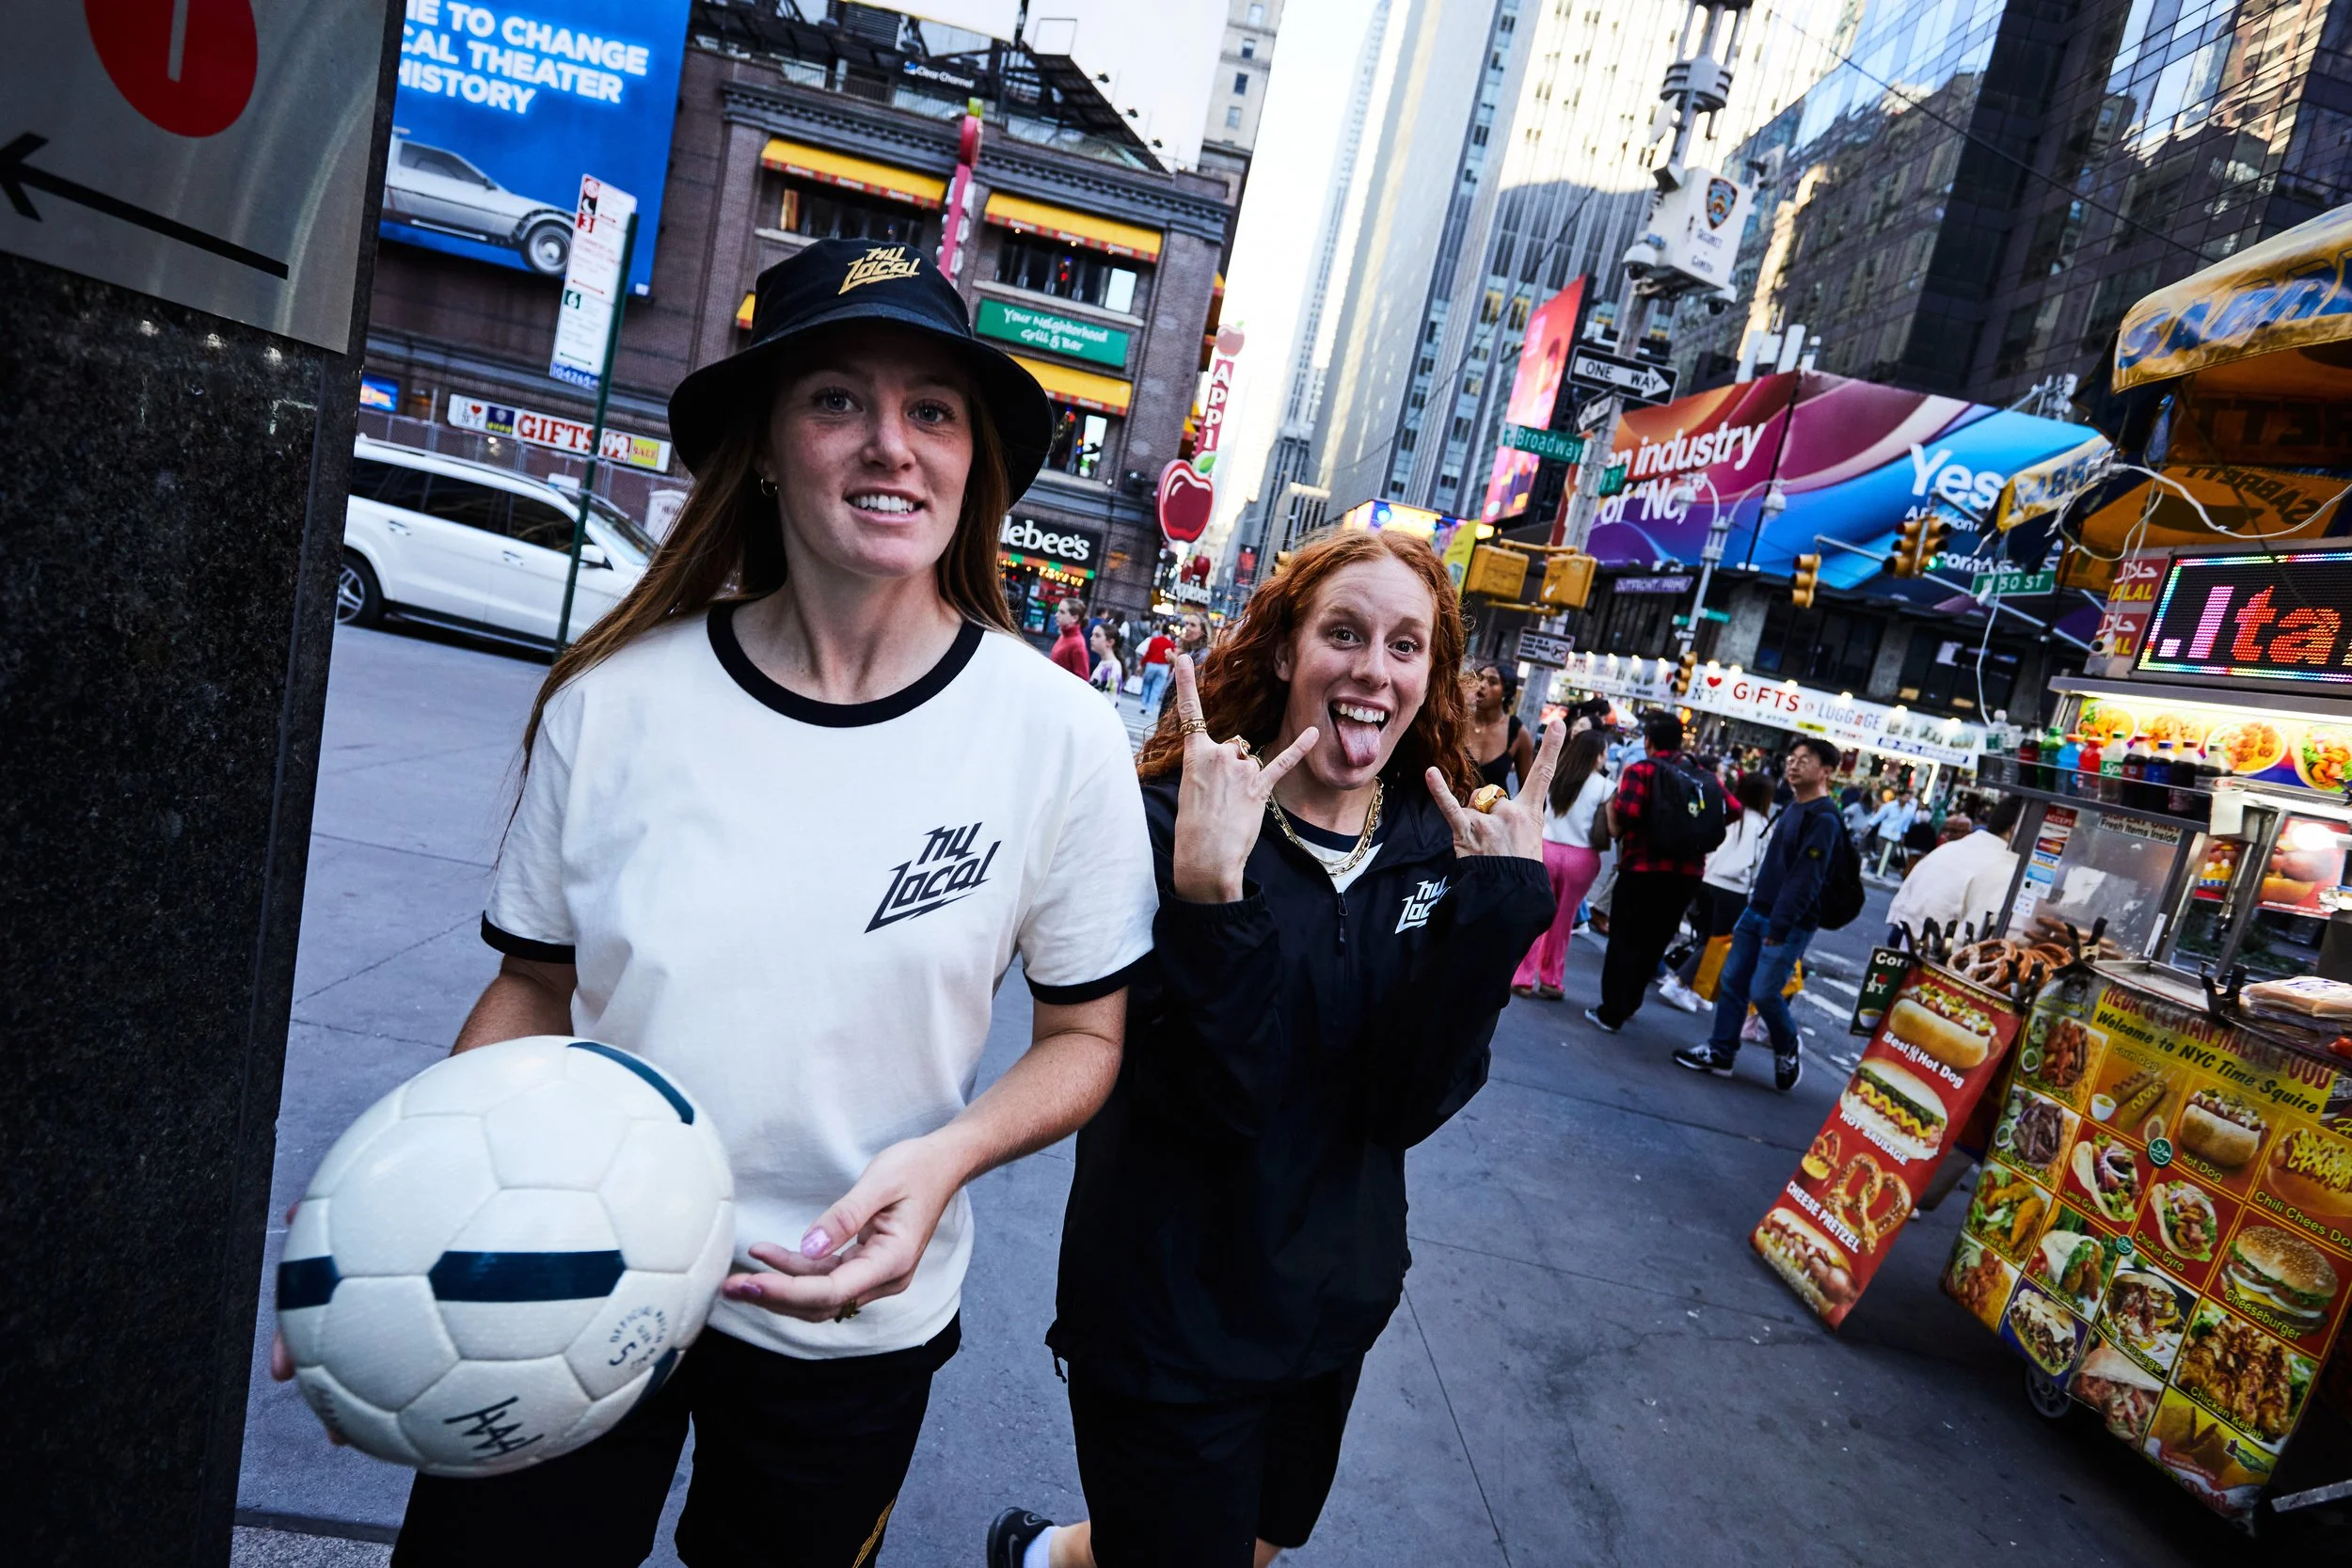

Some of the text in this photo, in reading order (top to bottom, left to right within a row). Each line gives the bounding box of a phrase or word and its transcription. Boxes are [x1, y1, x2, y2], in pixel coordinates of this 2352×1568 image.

[447, 2, 496, 38] TO
[501, 16, 650, 76] CHANGE
[468, 40, 624, 103] THEATER
[916, 65, 976, 89] Clear Channel
[580, 216, 592, 230] 3
[567, 293, 579, 308] 6
[1004, 308, 1108, 342] Your Neighborhood
[1021, 329, 1049, 343] Grill
[1062, 338, 1084, 351] Bar
[1585, 361, 1661, 391] ONE WAY
[518, 412, 594, 453] GIFTS
[1516, 428, 1582, 464] Broadway
[1633, 420, 1767, 477] industry
[1910, 443, 2004, 510] Yes
[1600, 483, 1632, 525] of
[1905, 505, 1918, 519] A
[1001, 515, 1090, 562] lebee's
[1661, 578, 1688, 593] PRIME
[1999, 576, 2020, 592] 50
[2025, 575, 2044, 590] ST
[1692, 687, 1719, 703] NY
[1733, 682, 1800, 712] GIFTS
[2045, 814, 2074, 828] ACCEPT
[2100, 818, 2178, 845] Fresh Items Inside
[1883, 1031, 1910, 1055] Best
[1916, 1051, 1941, 1073] Hot
[1939, 1065, 1965, 1090] Dog
[2096, 1010, 2320, 1114] Welcome to NYC Time Squire
[2113, 1044, 2158, 1073] Corn Dog
[1839, 1110, 1909, 1166] HOT SAUSAGE
[1993, 1146, 2055, 1188] Lamb Over Rice
[2182, 1152, 2223, 1183] Hot Dog
[1787, 1180, 1862, 1254] CHEESE PRETZEL
[2061, 1186, 2102, 1215] Lamb Gyro
[2254, 1191, 2352, 1253] Chili Chees Do
[2135, 1230, 2185, 1273] Chicken Gyro
[2224, 1289, 2301, 1341] Cheeseburger
[2120, 1335, 2163, 1373] Sausage
[2190, 1386, 2265, 1442] Chicken Kebab
